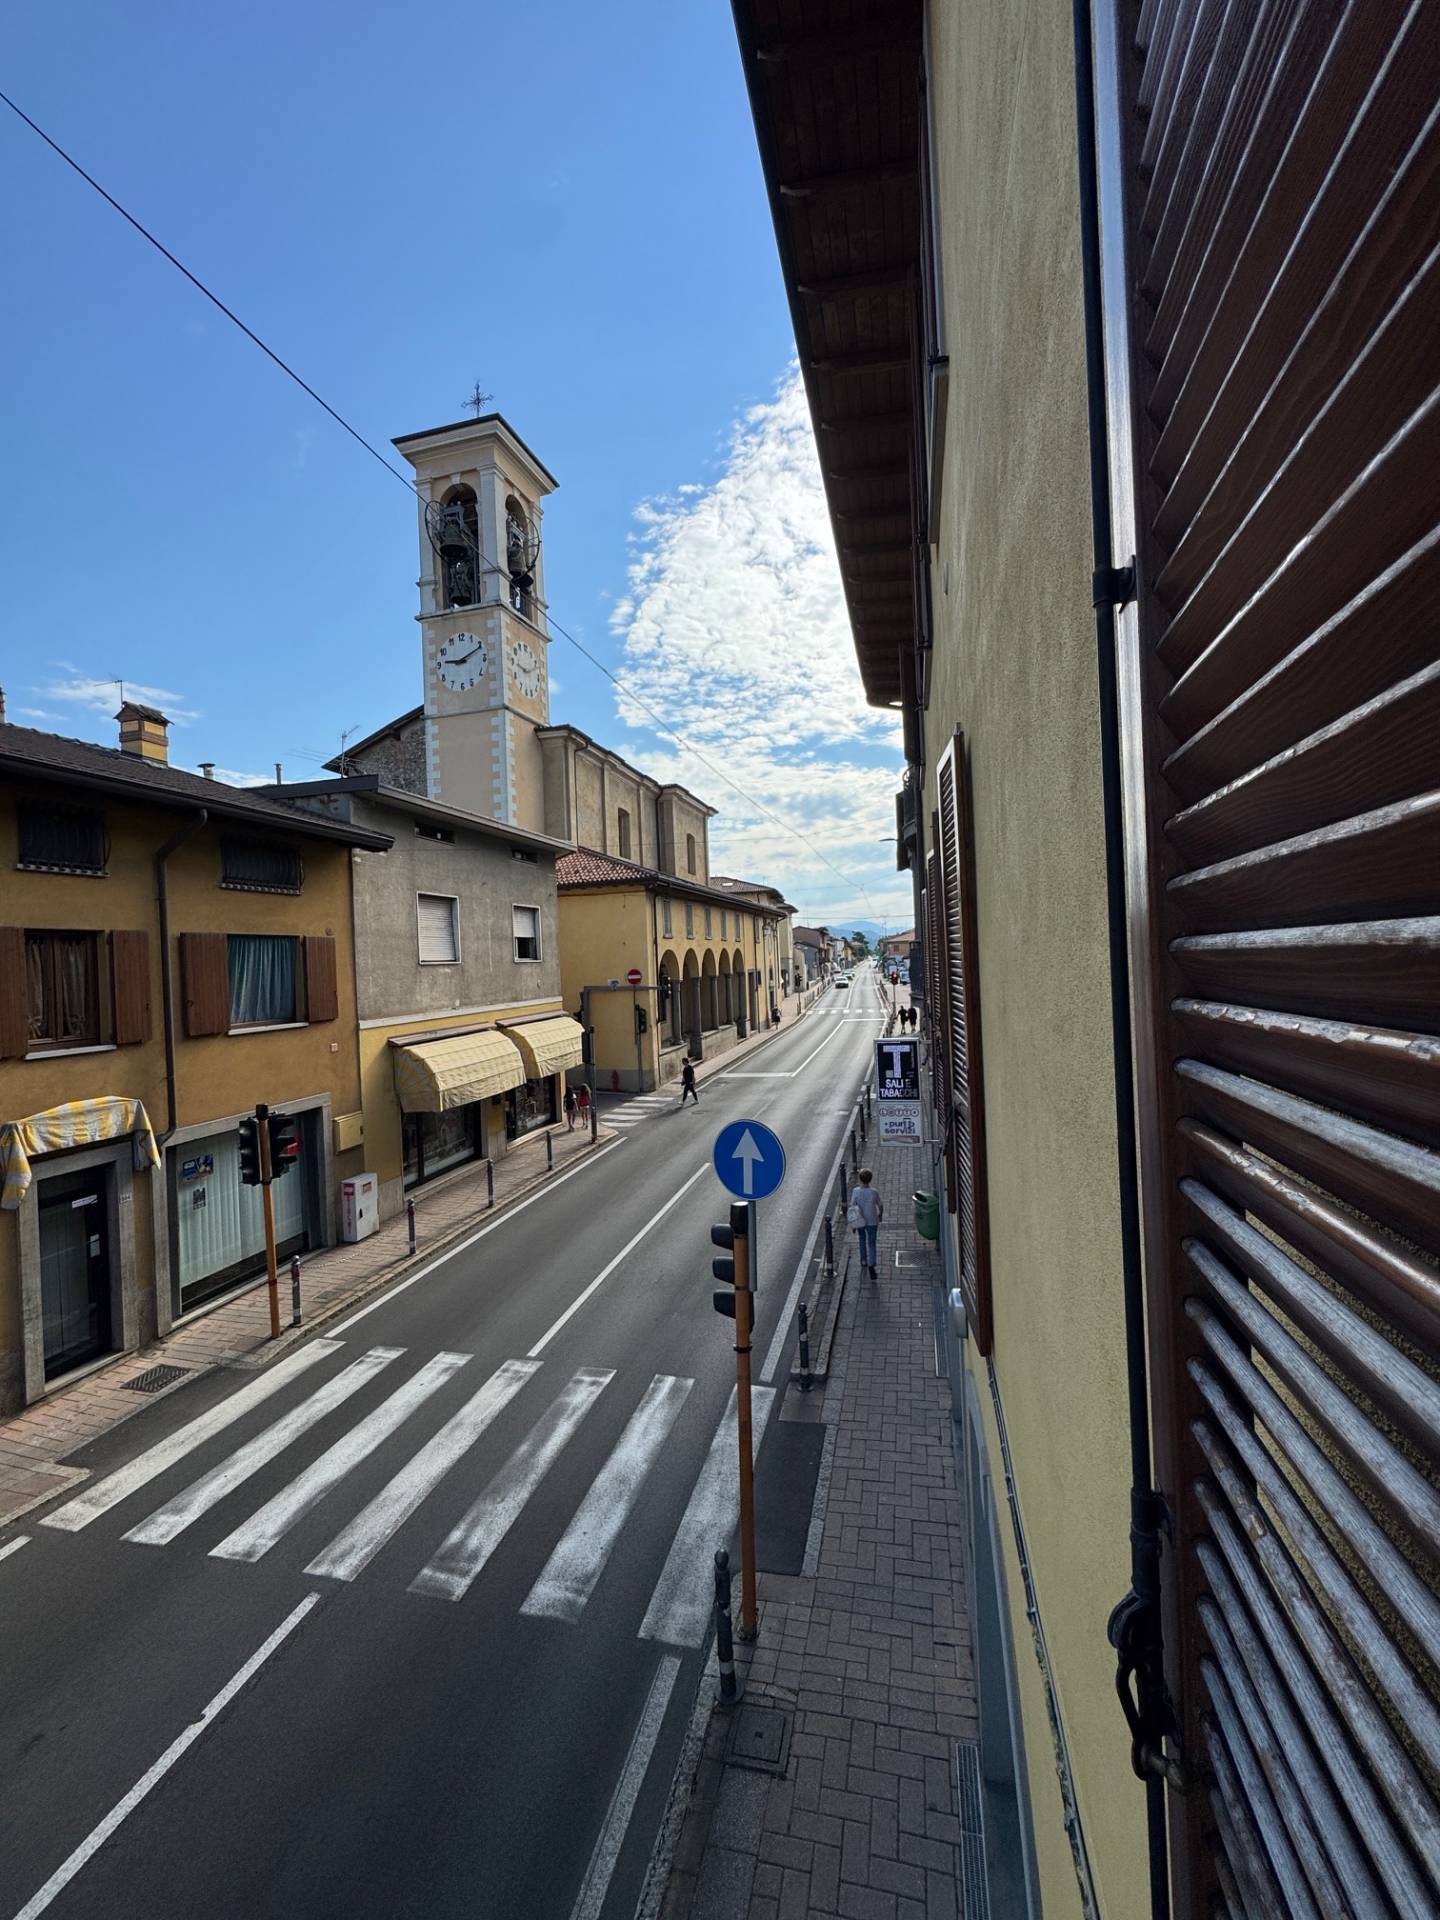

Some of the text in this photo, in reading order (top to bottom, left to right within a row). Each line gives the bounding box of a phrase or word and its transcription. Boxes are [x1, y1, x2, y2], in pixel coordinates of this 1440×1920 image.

[458, 632, 465, 642] 12
[440, 647, 447, 656] 10
[883, 1045, 911, 1078] T
[885, 1079, 911, 1088] SALI E
[880, 1088, 918, 1098] TABACCHI
[884, 1127, 916, 1135] servizi
